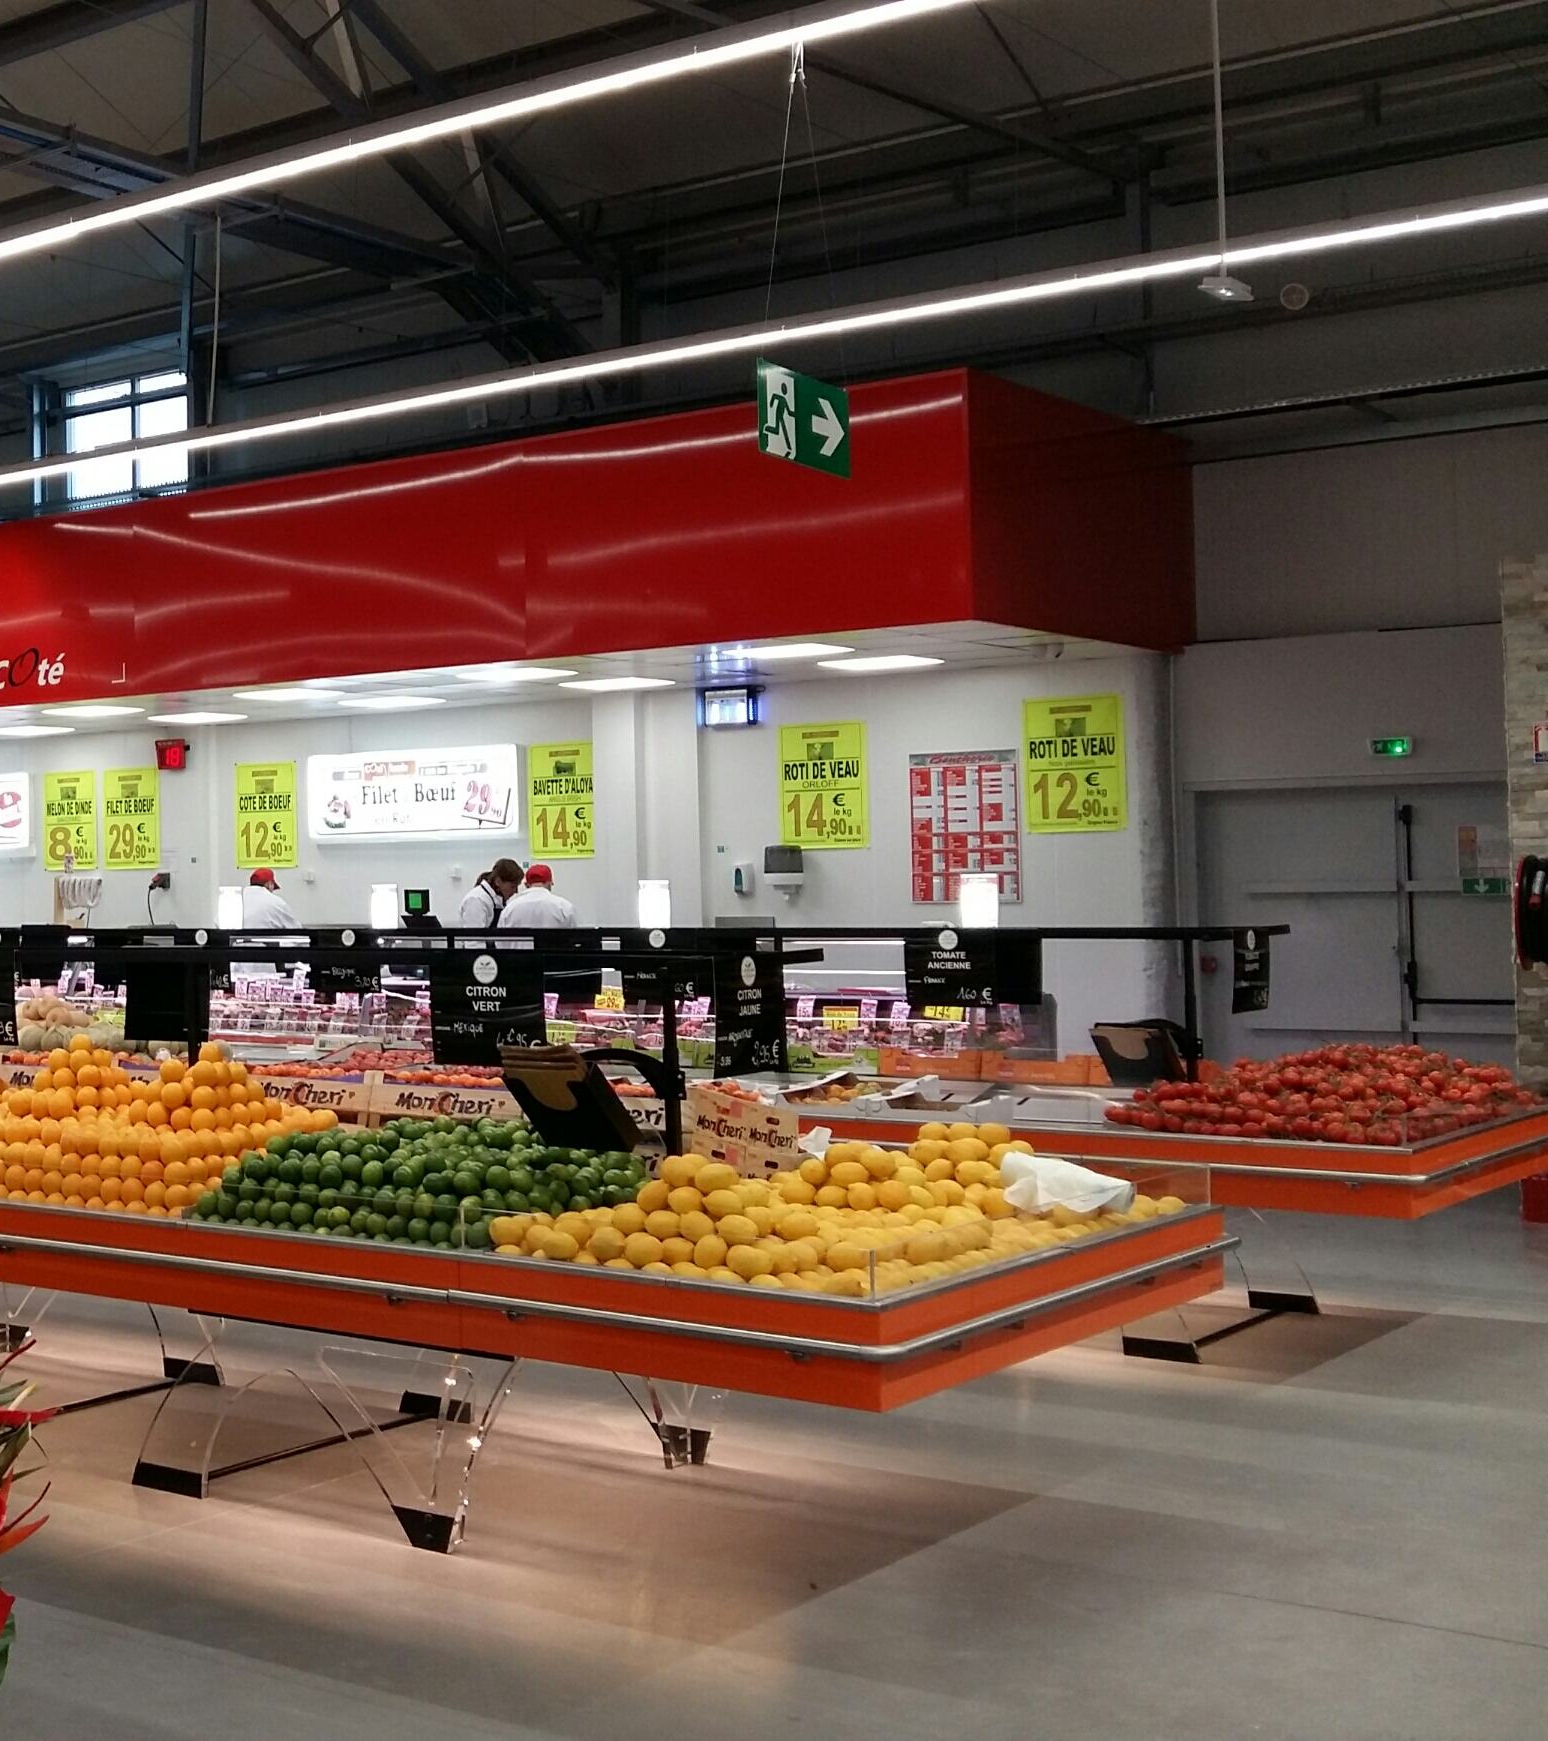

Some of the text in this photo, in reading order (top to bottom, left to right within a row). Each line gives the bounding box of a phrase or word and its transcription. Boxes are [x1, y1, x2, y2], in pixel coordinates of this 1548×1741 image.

[1029, 736, 1116, 760] ROTI DE VEAU
[784, 760, 859, 781] ROTI DE VEAU
[534, 776, 593, 796] BAVETTE D'ALOYA
[802, 780, 839, 788] ORLOFF
[67, 801, 74, 815] DE
[107, 798, 155, 815] FILET DE BOEUF
[240, 794, 291, 810] COTE DE BOEUF
[931, 951, 967, 960] TOMATE
[927, 961, 971, 970] ANCIENNE
[466, 986, 507, 997] CITRON
[737, 989, 762, 1001] CITRON
[472, 1001, 500, 1012] VERT
[738, 1003, 761, 1016] JAUNE
